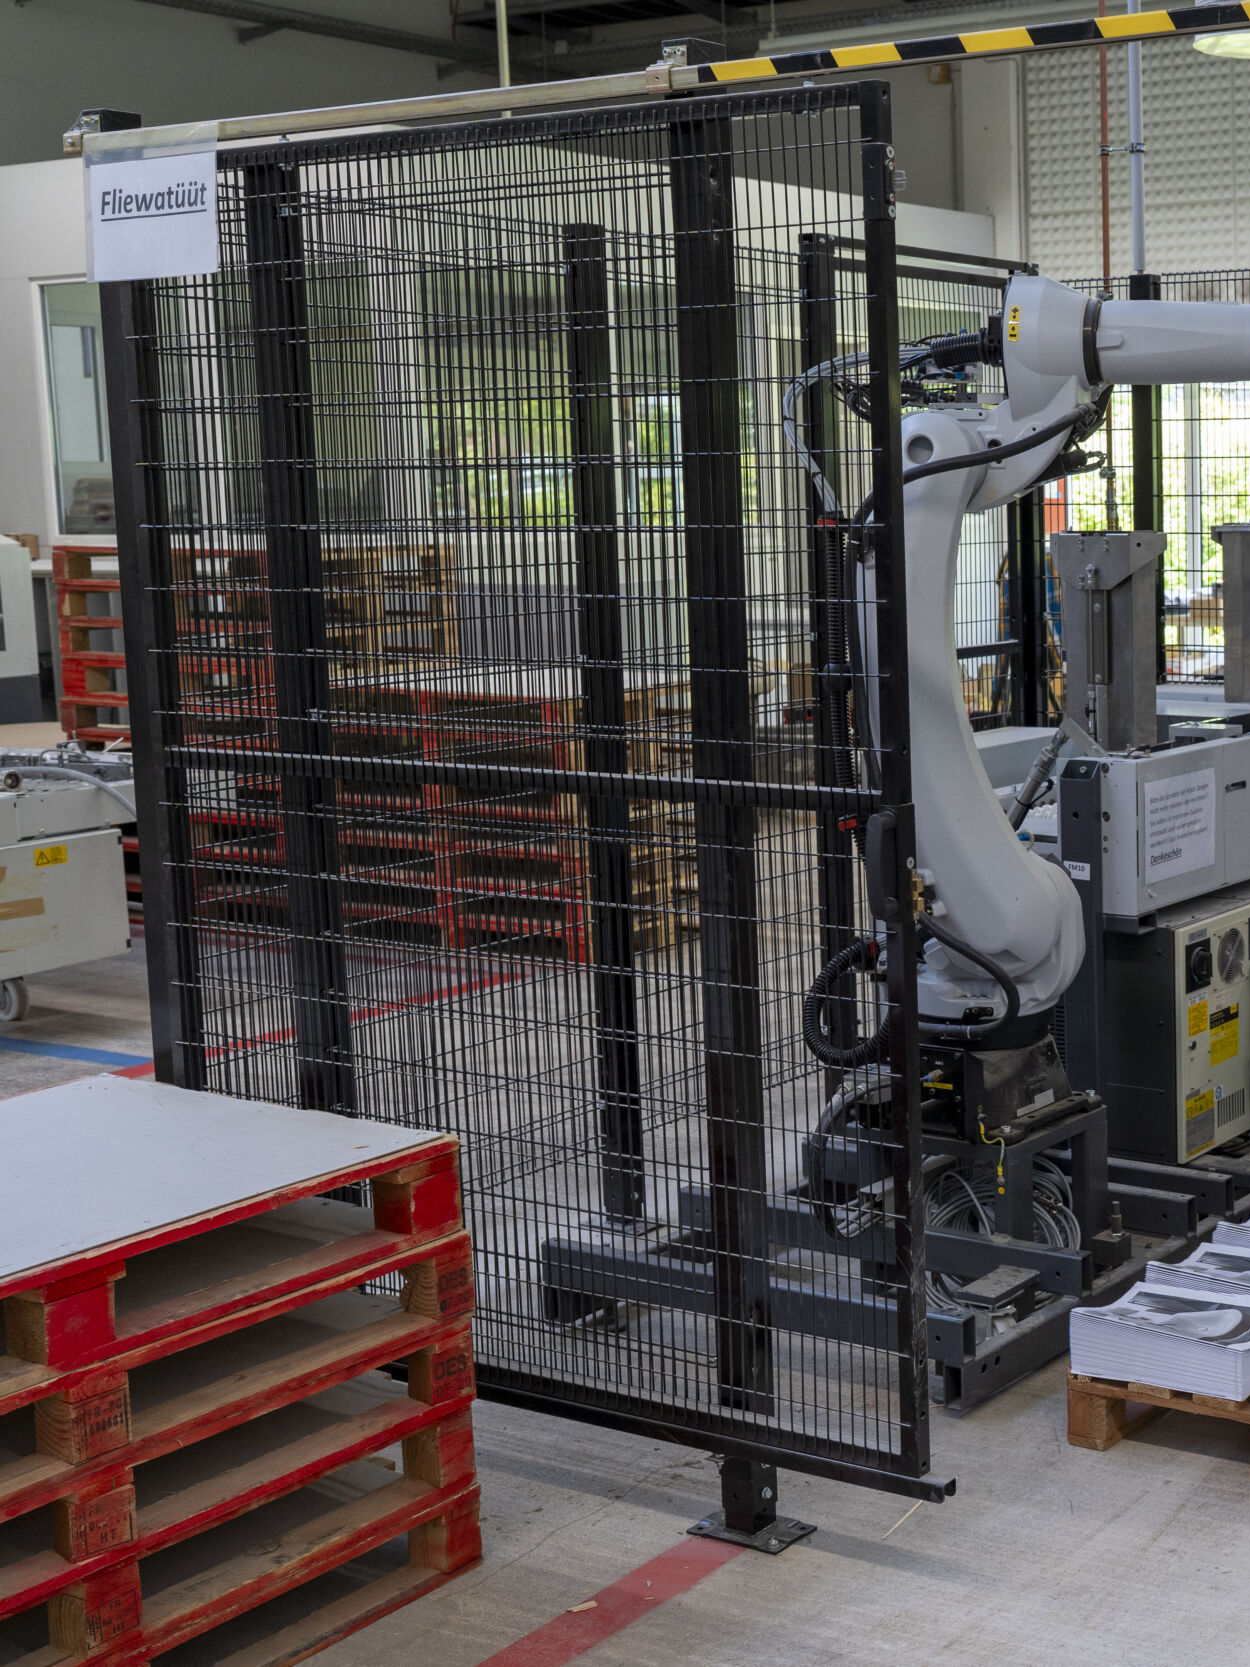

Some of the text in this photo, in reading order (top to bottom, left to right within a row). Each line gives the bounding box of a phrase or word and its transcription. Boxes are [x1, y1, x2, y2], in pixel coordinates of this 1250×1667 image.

[101, 181, 207, 216] Fliewatüüt
[1150, 848, 1182, 864] Dankeschön
[1068, 863, 1086, 872] FM10
[434, 1353, 468, 1380] DES
